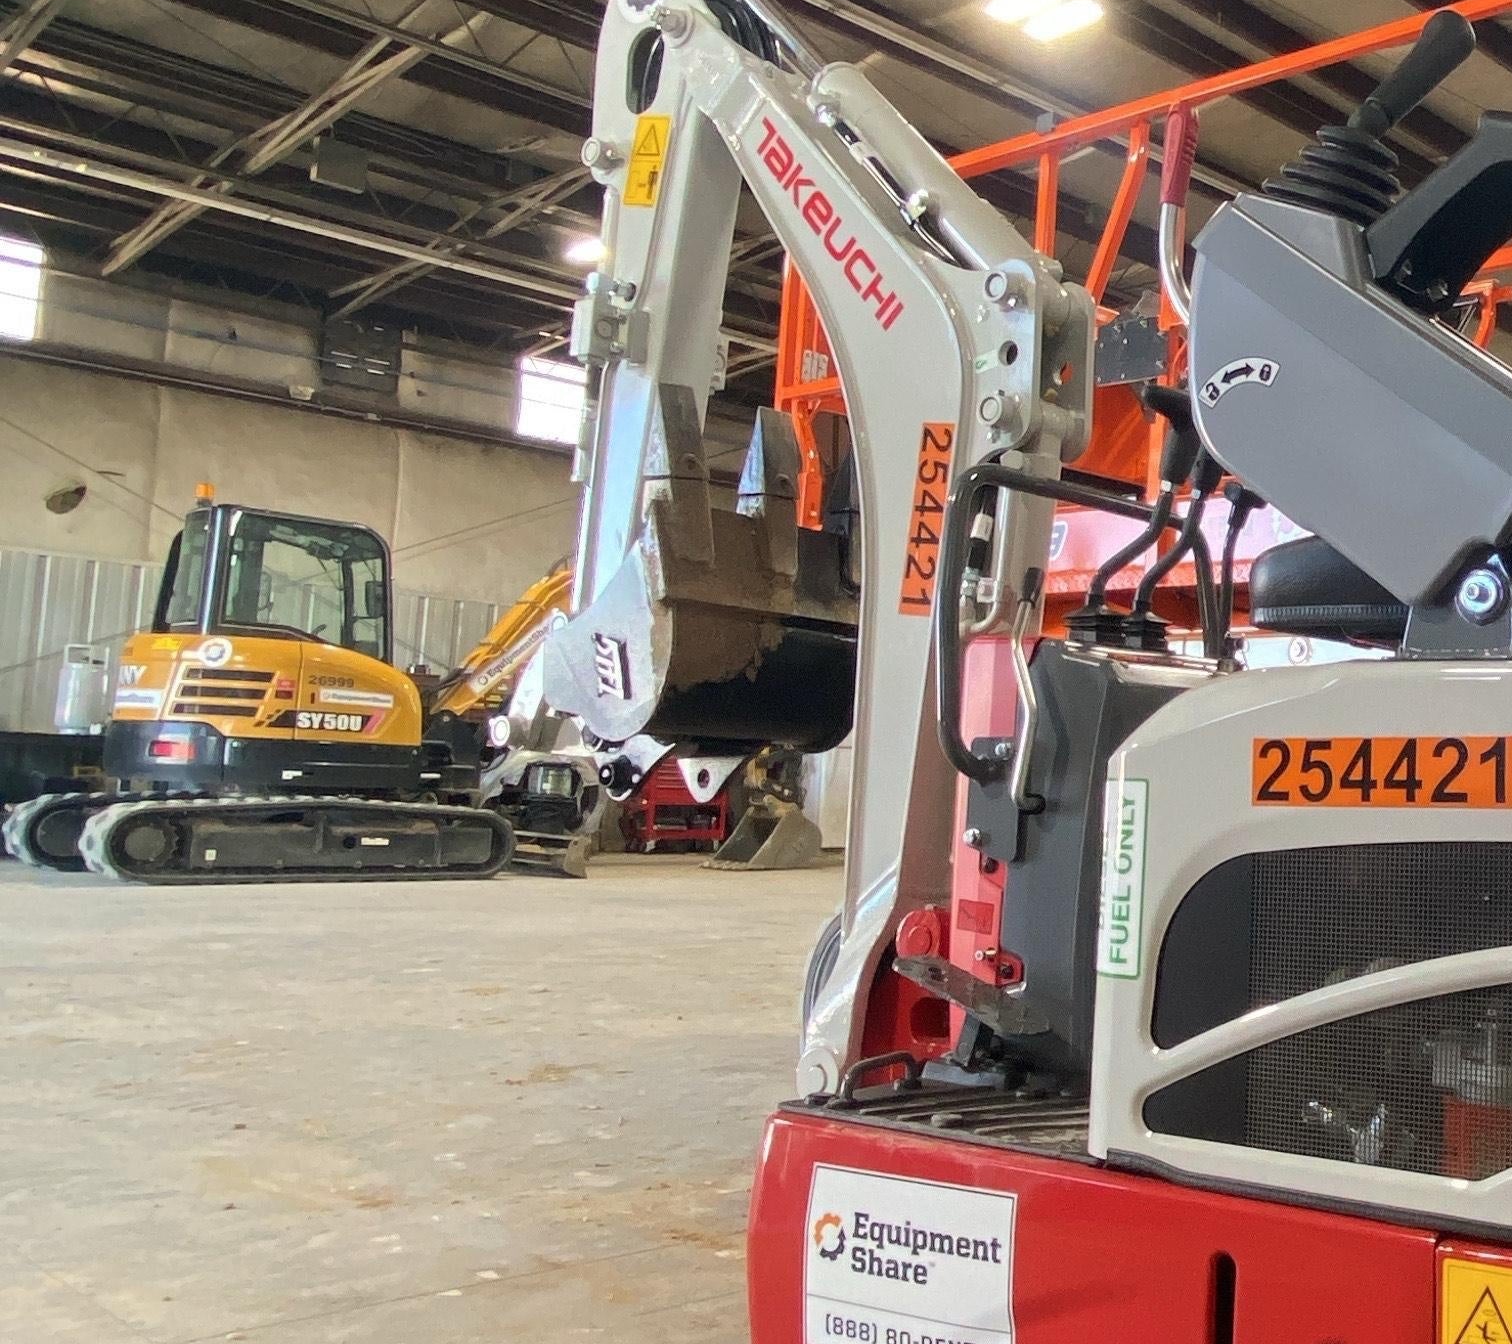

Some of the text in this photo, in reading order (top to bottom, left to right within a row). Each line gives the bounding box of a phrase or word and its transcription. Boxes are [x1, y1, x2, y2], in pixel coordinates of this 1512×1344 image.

[901, 426, 954, 607] 254421
[297, 712, 363, 733] SY50U
[1255, 736, 1507, 804] 254421
[1109, 797, 1136, 965] FUEL ONLY
[851, 1246, 929, 1285] Share
[852, 1211, 1002, 1264] Equipment
